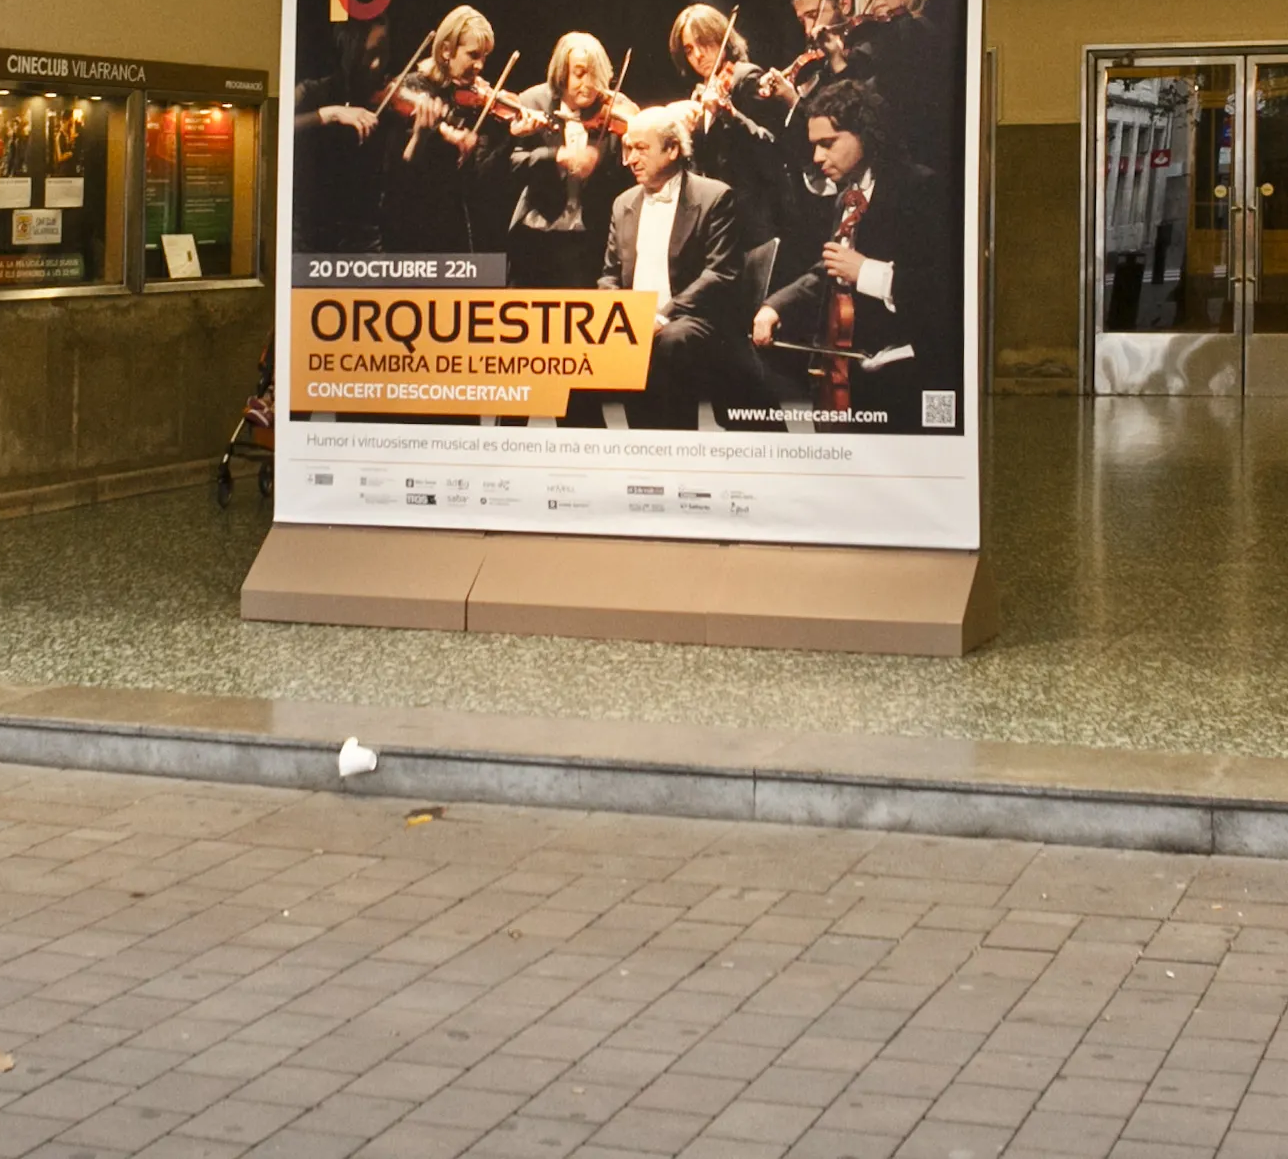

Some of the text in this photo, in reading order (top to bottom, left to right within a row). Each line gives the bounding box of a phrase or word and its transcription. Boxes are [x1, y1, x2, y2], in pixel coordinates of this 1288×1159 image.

[6, 54, 146, 82] CINECLUB VILAFRANCA
[309, 260, 477, 278] 20 D'OCTUBRE 22h
[310, 299, 638, 353] ORQUESTRA
[309, 353, 594, 376] DE CAMBRA DE L'EMPORDÀ
[307, 382, 531, 402] CONCERT DESCONCERTANT
[728, 407, 888, 423] www.teatrecasal.com
[307, 434, 348, 447] Humor
[358, 435, 428, 449] virtuosisme
[431, 437, 479, 451] musical
[483, 441, 497, 451] es
[501, 438, 542, 452] donen
[546, 439, 556, 453] la
[560, 440, 581, 453] mà
[584, 444, 600, 454] en
[604, 445, 620, 455] un
[624, 442, 672, 456] concert
[676, 442, 706, 457] molt
[711, 443, 766, 461] especial
[777, 445, 853, 461] inoblidable
